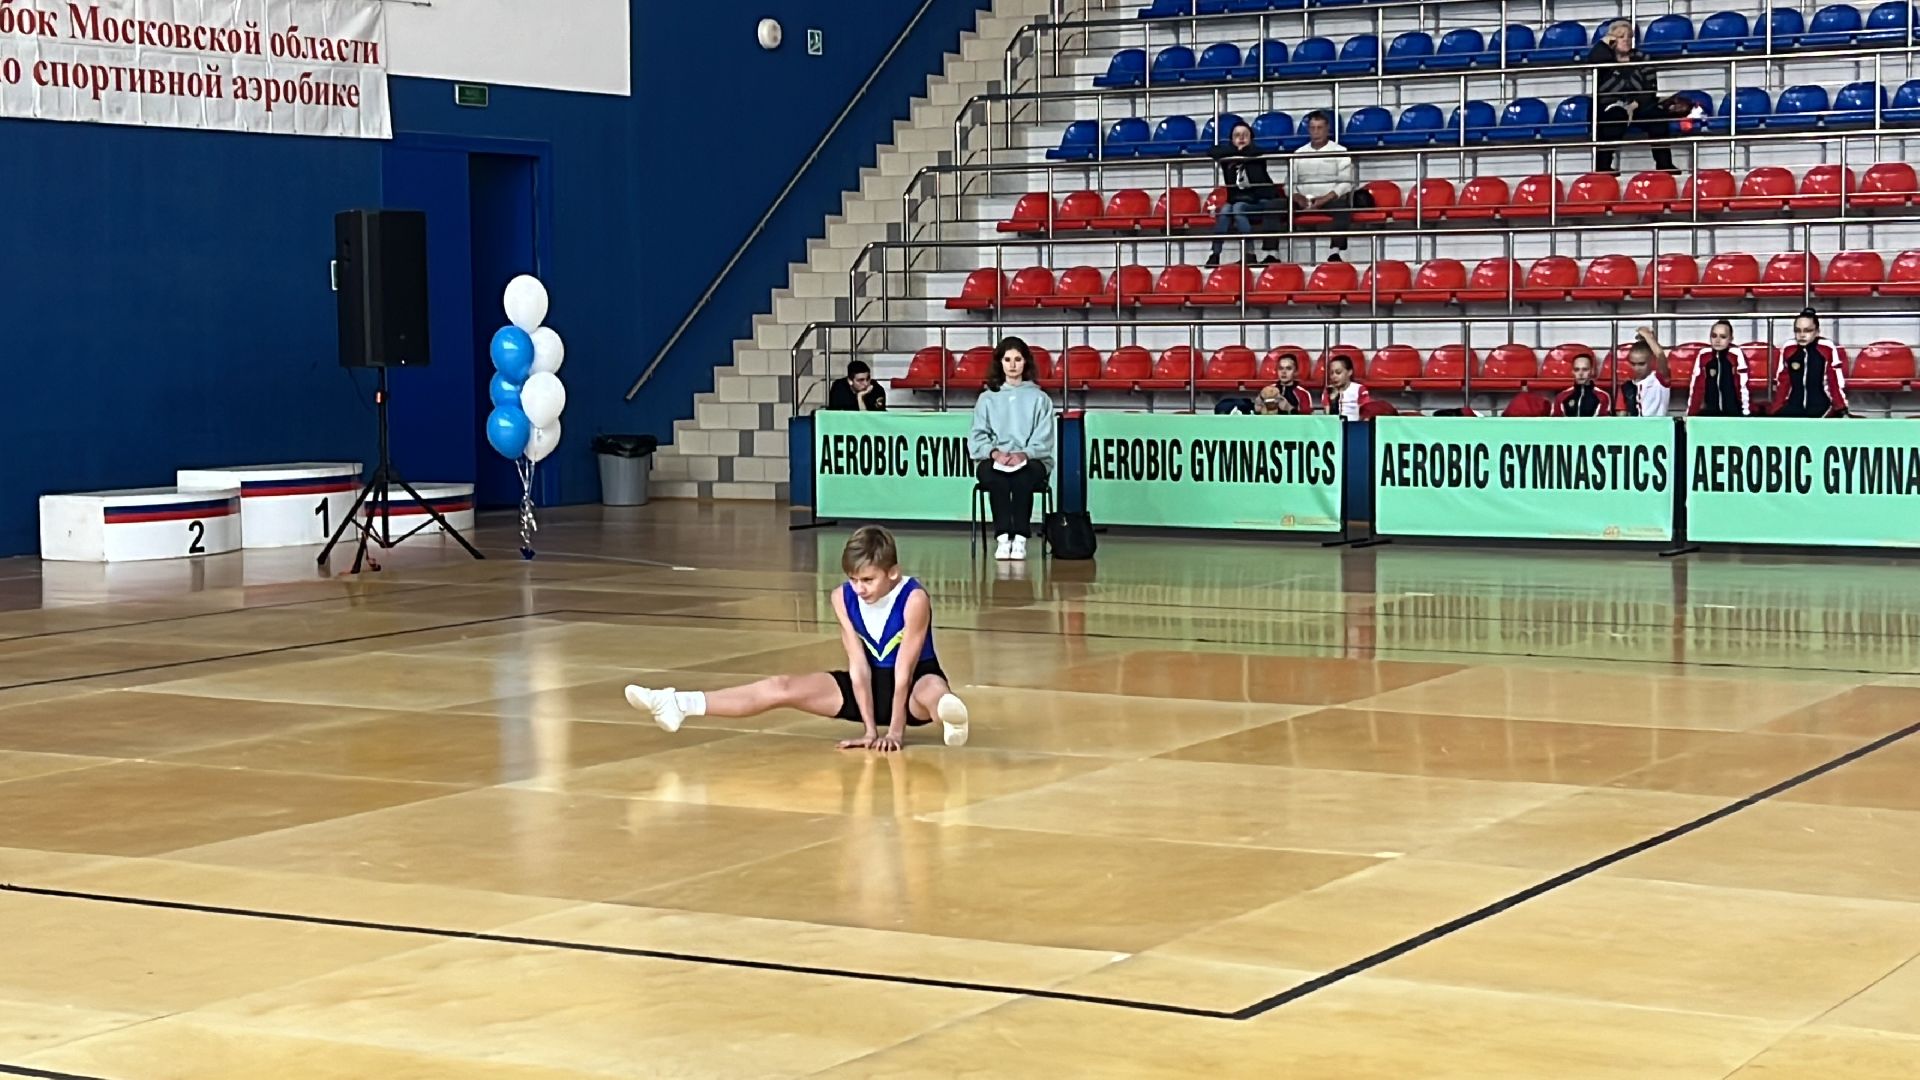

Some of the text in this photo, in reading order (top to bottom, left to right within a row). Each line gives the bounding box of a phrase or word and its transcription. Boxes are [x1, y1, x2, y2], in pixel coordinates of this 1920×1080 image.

[67, 2, 262, 55] Московской
[270, 25, 379, 64] области
[0, 57, 360, 112] о спортивной аэробике
[820, 434, 909, 477] AEROBIC
[1088, 438, 1336, 486] AEROBIC GYMNASTICS
[1380, 442, 1668, 492] AEROBIC GYMNASTICS
[1692, 444, 1920, 495] AEROBIC GYMNA
[188, 520, 205, 553] 2
[315, 497, 330, 538] 1
